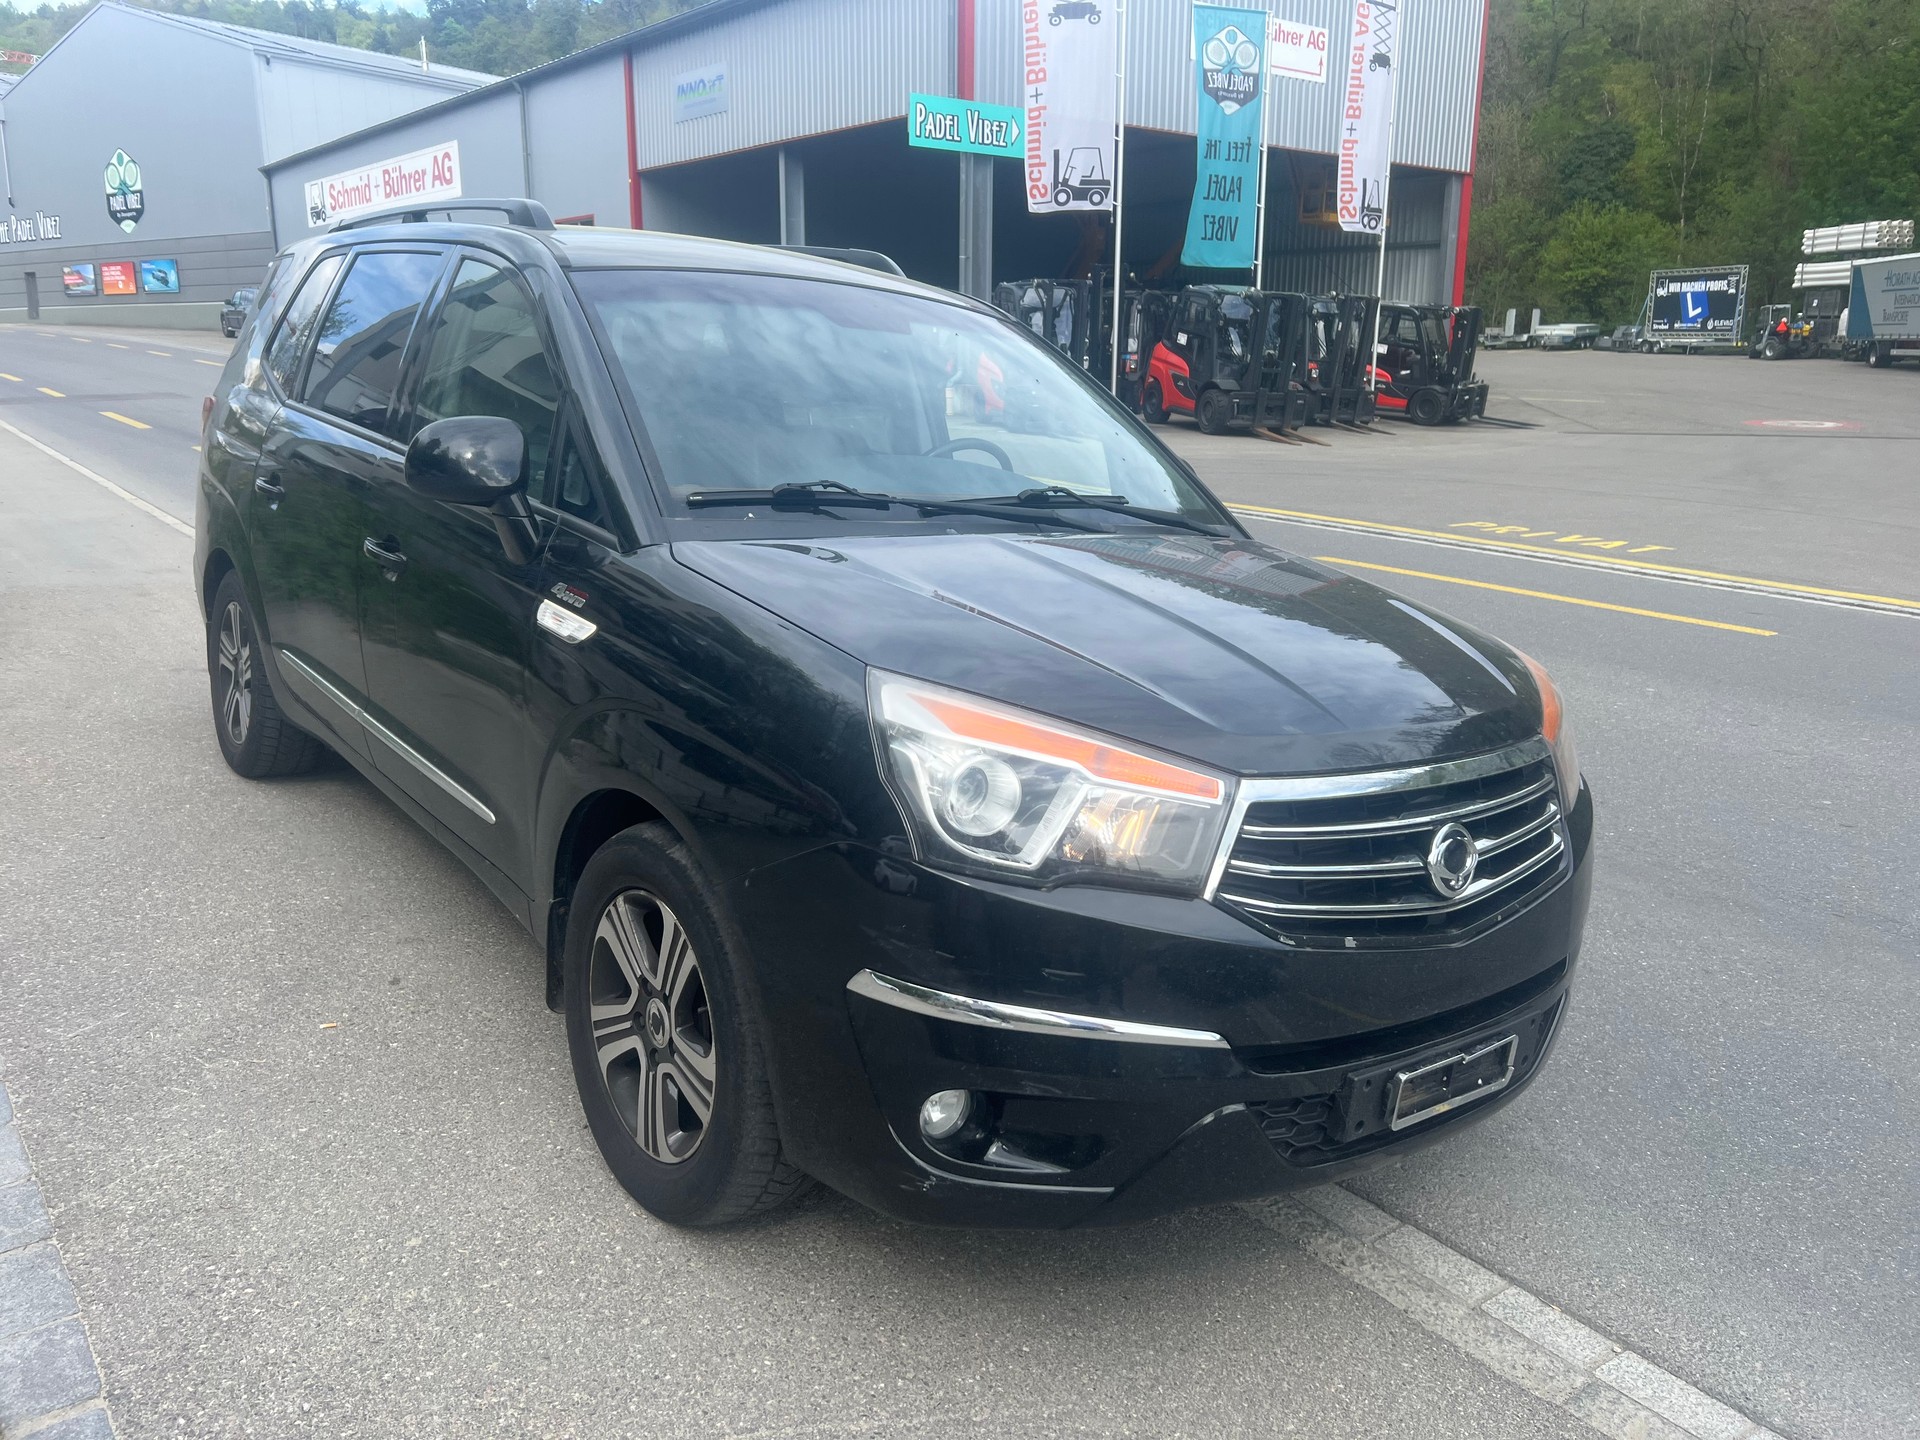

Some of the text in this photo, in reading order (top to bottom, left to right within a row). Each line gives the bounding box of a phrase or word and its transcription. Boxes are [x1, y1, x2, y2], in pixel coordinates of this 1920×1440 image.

[1307, 30, 1326, 51] AG
[328, 173, 372, 212] Schmid
[382, 164, 428, 199] Bührer
[431, 151, 454, 189] AG
[0, 221, 10, 244] HE
[1669, 282, 1681, 293] WIR
[1681, 281, 1706, 292] MACHEN
[1686, 291, 1702, 318] L
[1448, 521, 1678, 553] PRIVAT
